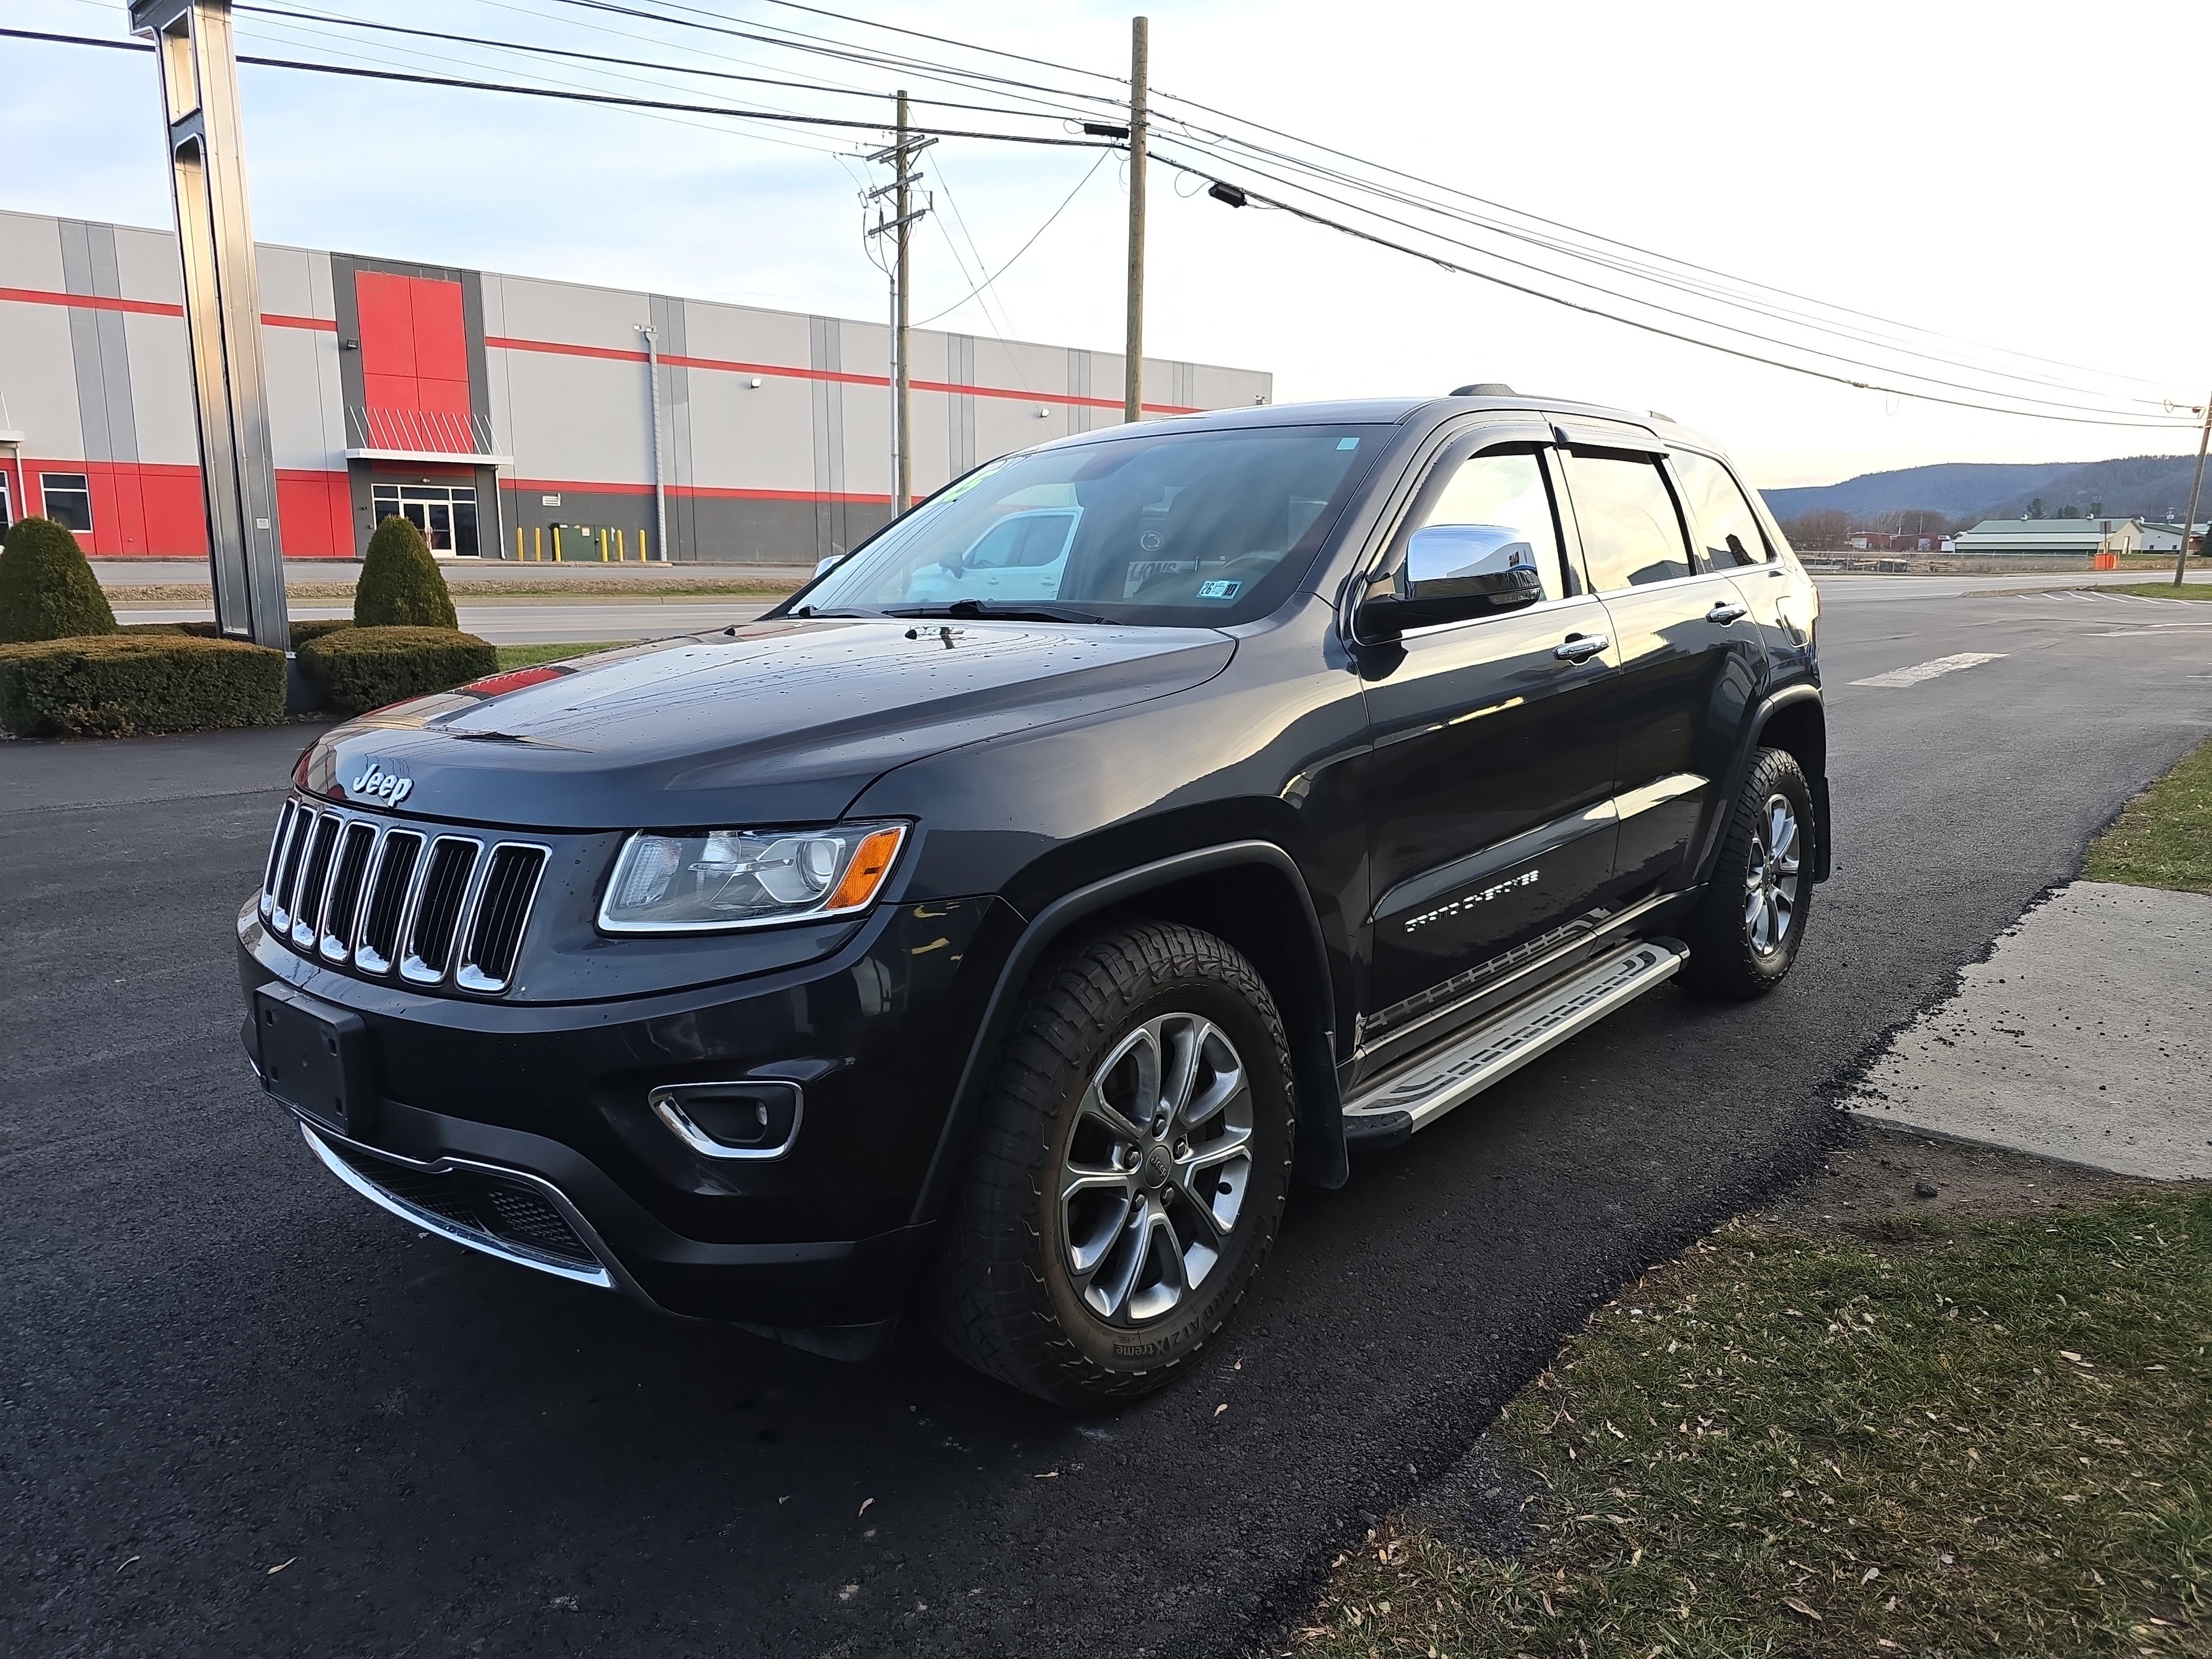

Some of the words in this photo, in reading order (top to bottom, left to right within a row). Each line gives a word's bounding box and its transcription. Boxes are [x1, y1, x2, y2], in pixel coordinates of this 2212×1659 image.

[1200, 582, 1215, 595] 26
[1224, 583, 1238, 596] 10
[352, 763, 414, 808] Jeep
[1150, 1155, 1168, 1178] Jeep
[1171, 1316, 1200, 1348] AT2
[1116, 1338, 1168, 1356] Xtreme
